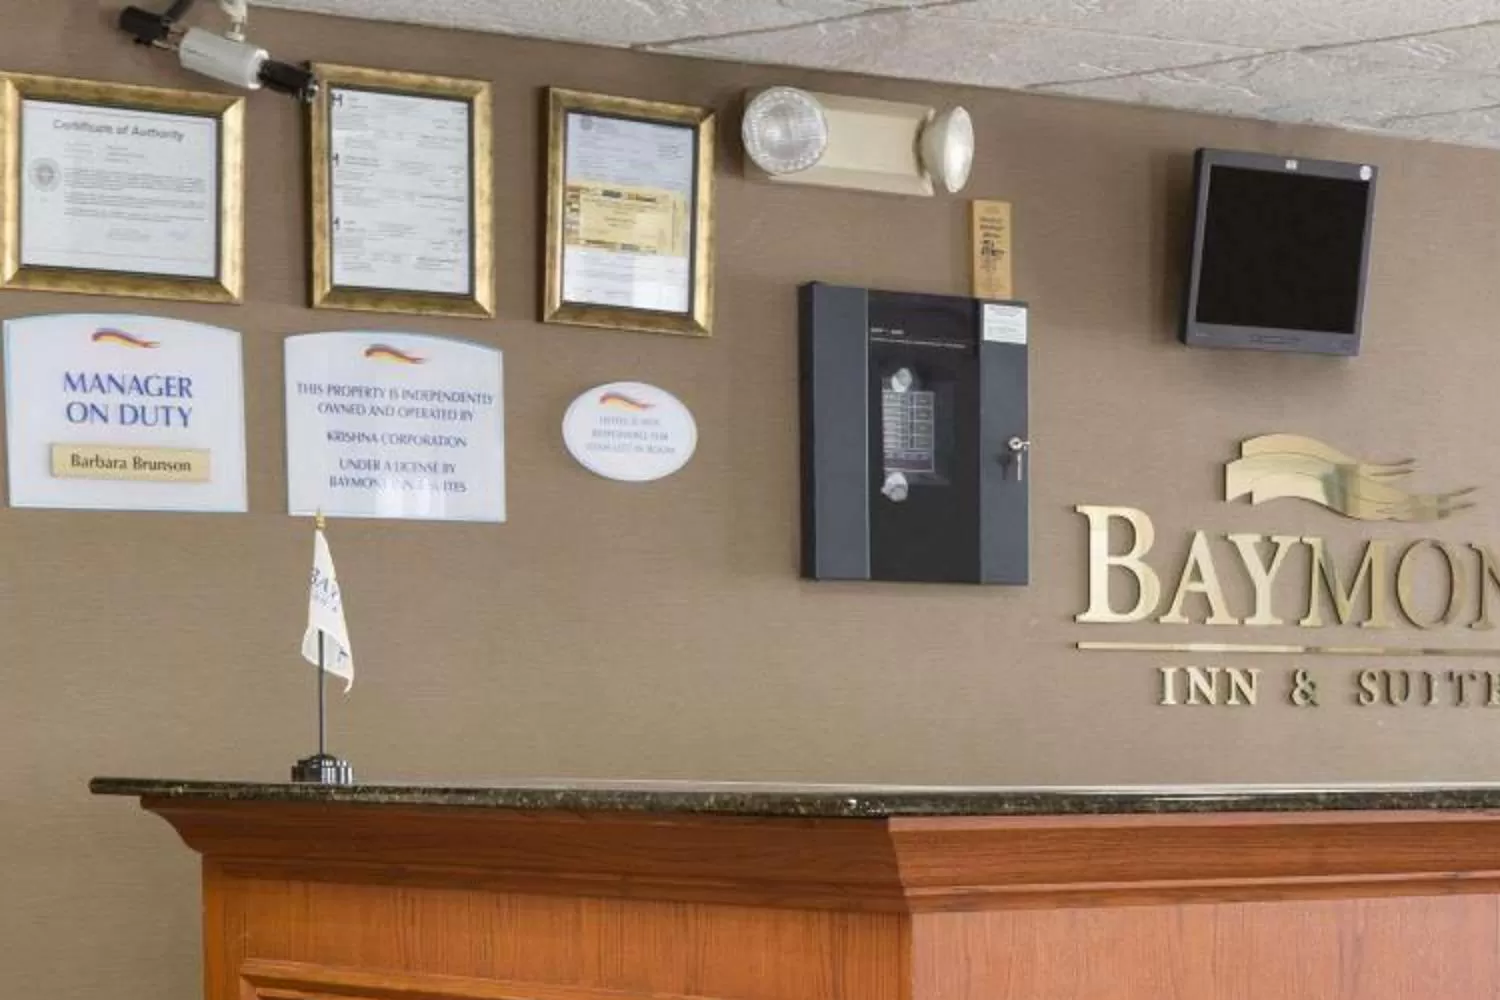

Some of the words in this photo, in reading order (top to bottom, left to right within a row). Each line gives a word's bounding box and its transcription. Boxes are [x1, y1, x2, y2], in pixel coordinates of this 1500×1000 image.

[52, 118, 114, 135] Certificate
[115, 124, 130, 135] of
[131, 126, 186, 142] Authority
[63, 371, 193, 398] MANAGER
[297, 382, 323, 395] THIS
[327, 383, 386, 399] PROPERTY
[389, 387, 399, 400] IS
[402, 388, 495, 406] INDEPENDENTLY
[66, 401, 109, 424] ON
[119, 403, 193, 429] DUTY
[317, 402, 367, 416] OWNED
[368, 404, 395, 417] AND
[397, 406, 457, 421] OPERATED
[459, 409, 474, 423] BY
[326, 430, 378, 444] KRISHNA
[381, 432, 468, 448] CORPORATION
[70, 453, 128, 470] Barbara
[132, 456, 192, 473] Brunson
[338, 457, 380, 472] UNDER
[383, 459, 393, 472] A
[394, 460, 438, 474] LICENSE
[442, 462, 457, 474] BY
[329, 475, 384, 490] BAYMON
[1157, 666, 1262, 706] INN
[1288, 669, 1320, 706] &
